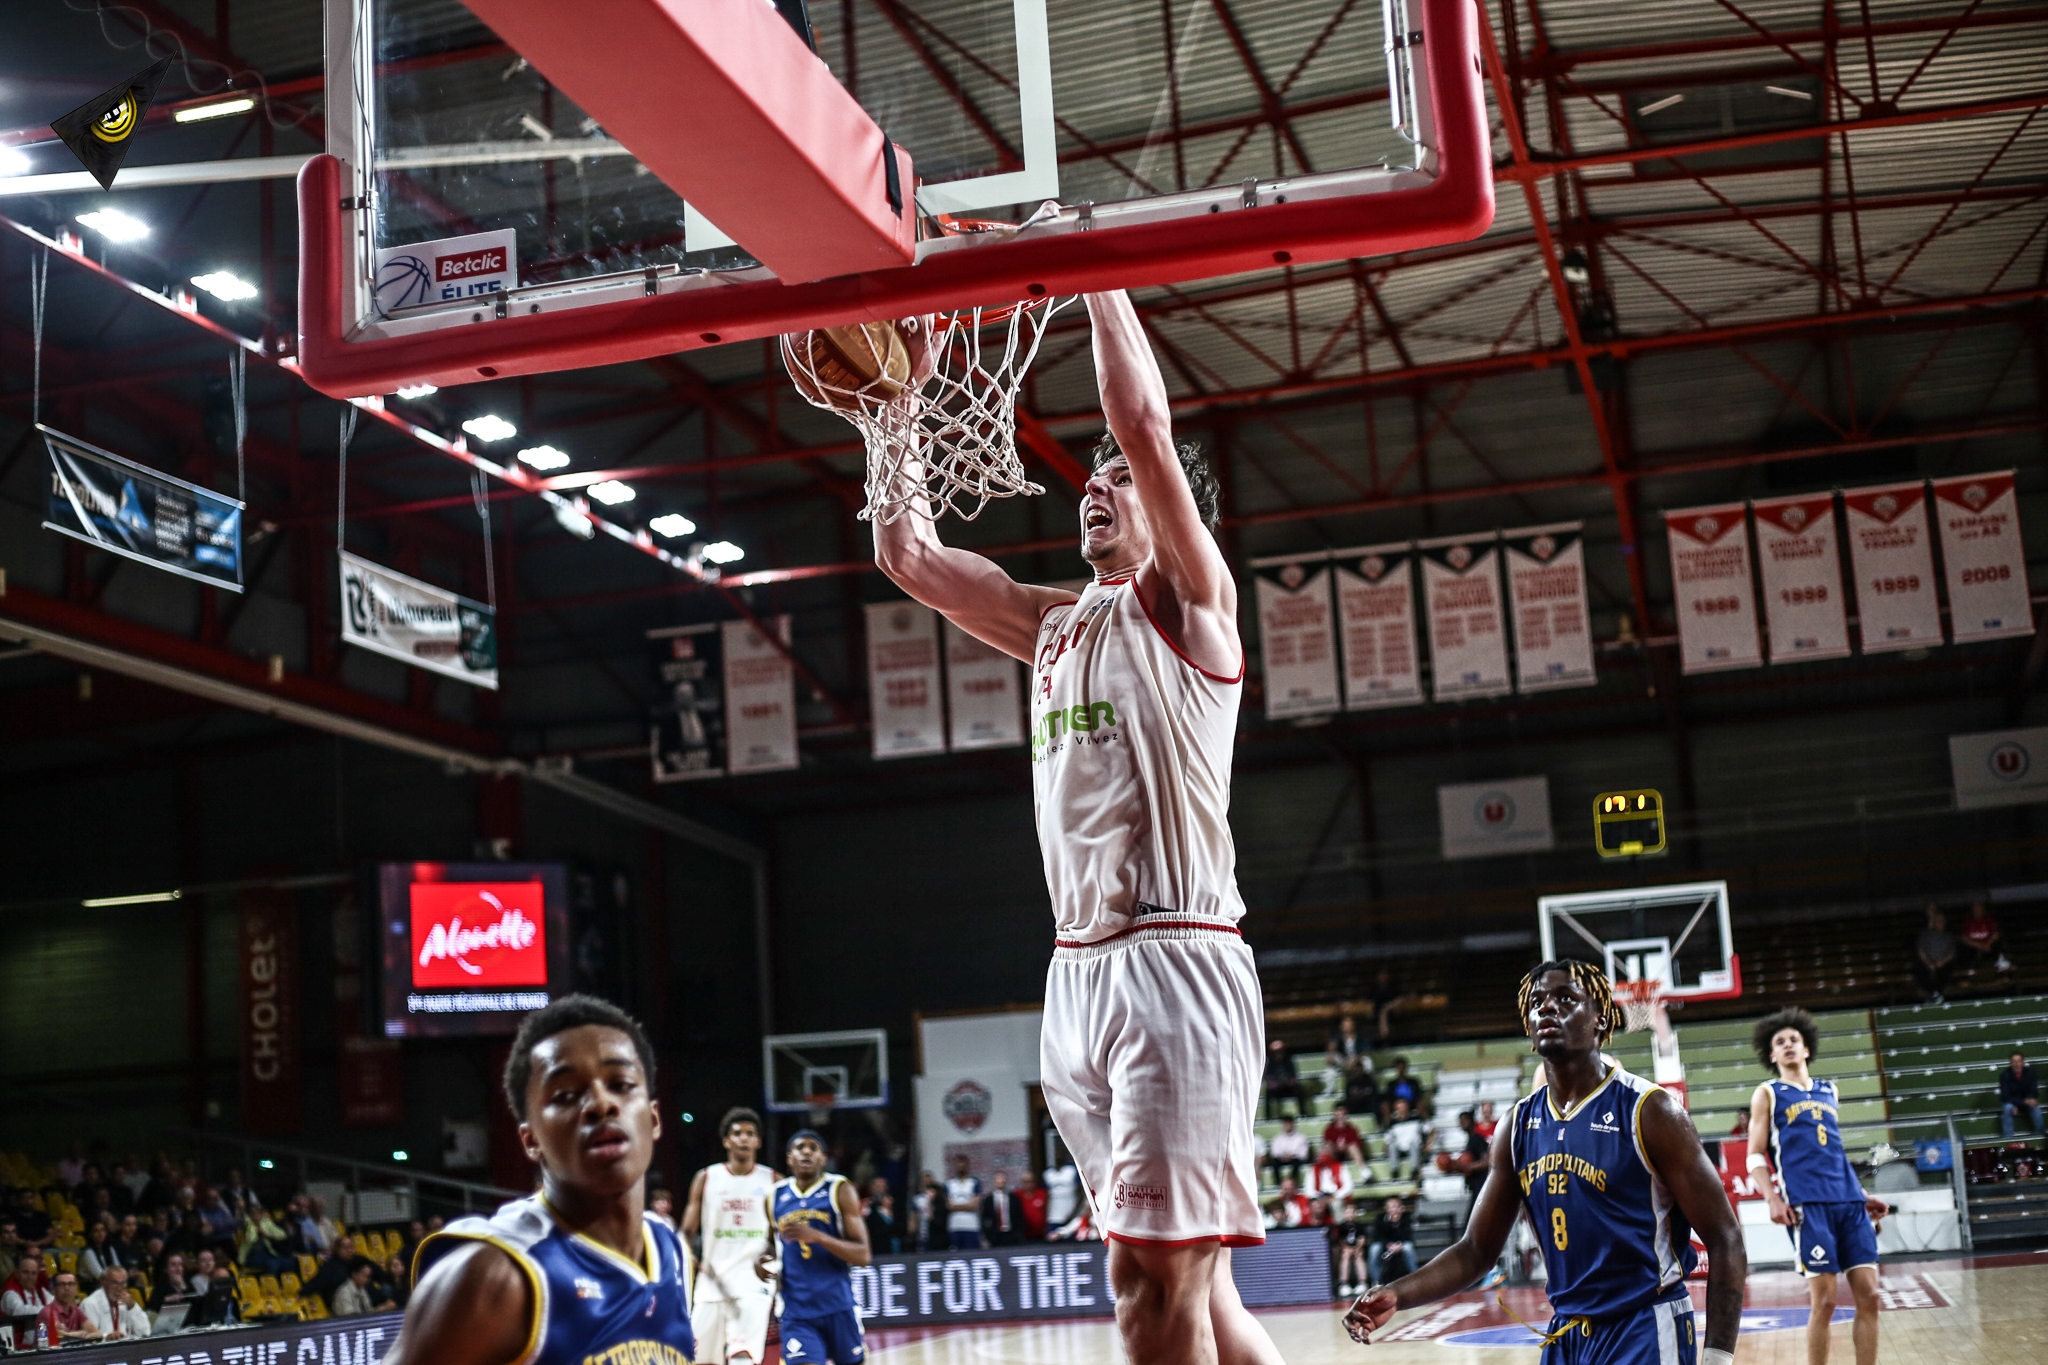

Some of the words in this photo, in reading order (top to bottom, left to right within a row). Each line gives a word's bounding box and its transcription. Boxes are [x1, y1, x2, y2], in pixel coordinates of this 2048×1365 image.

[441, 252, 502, 277] Betclic
[1961, 564, 2011, 586] 2008
[1075, 733, 1118, 745] Vivez
[1816, 1122, 1828, 1147] 6
[1518, 1153, 1608, 1198] METROPOLITANS
[1547, 1173, 1569, 1195] 92
[1128, 1191, 1165, 1201] GAUTIER
[1551, 1206, 1569, 1251] 8
[917, 1257, 1004, 1315] FOR
[1009, 1252, 1096, 1310] THE
[1685, 1319, 1693, 1346] 8
